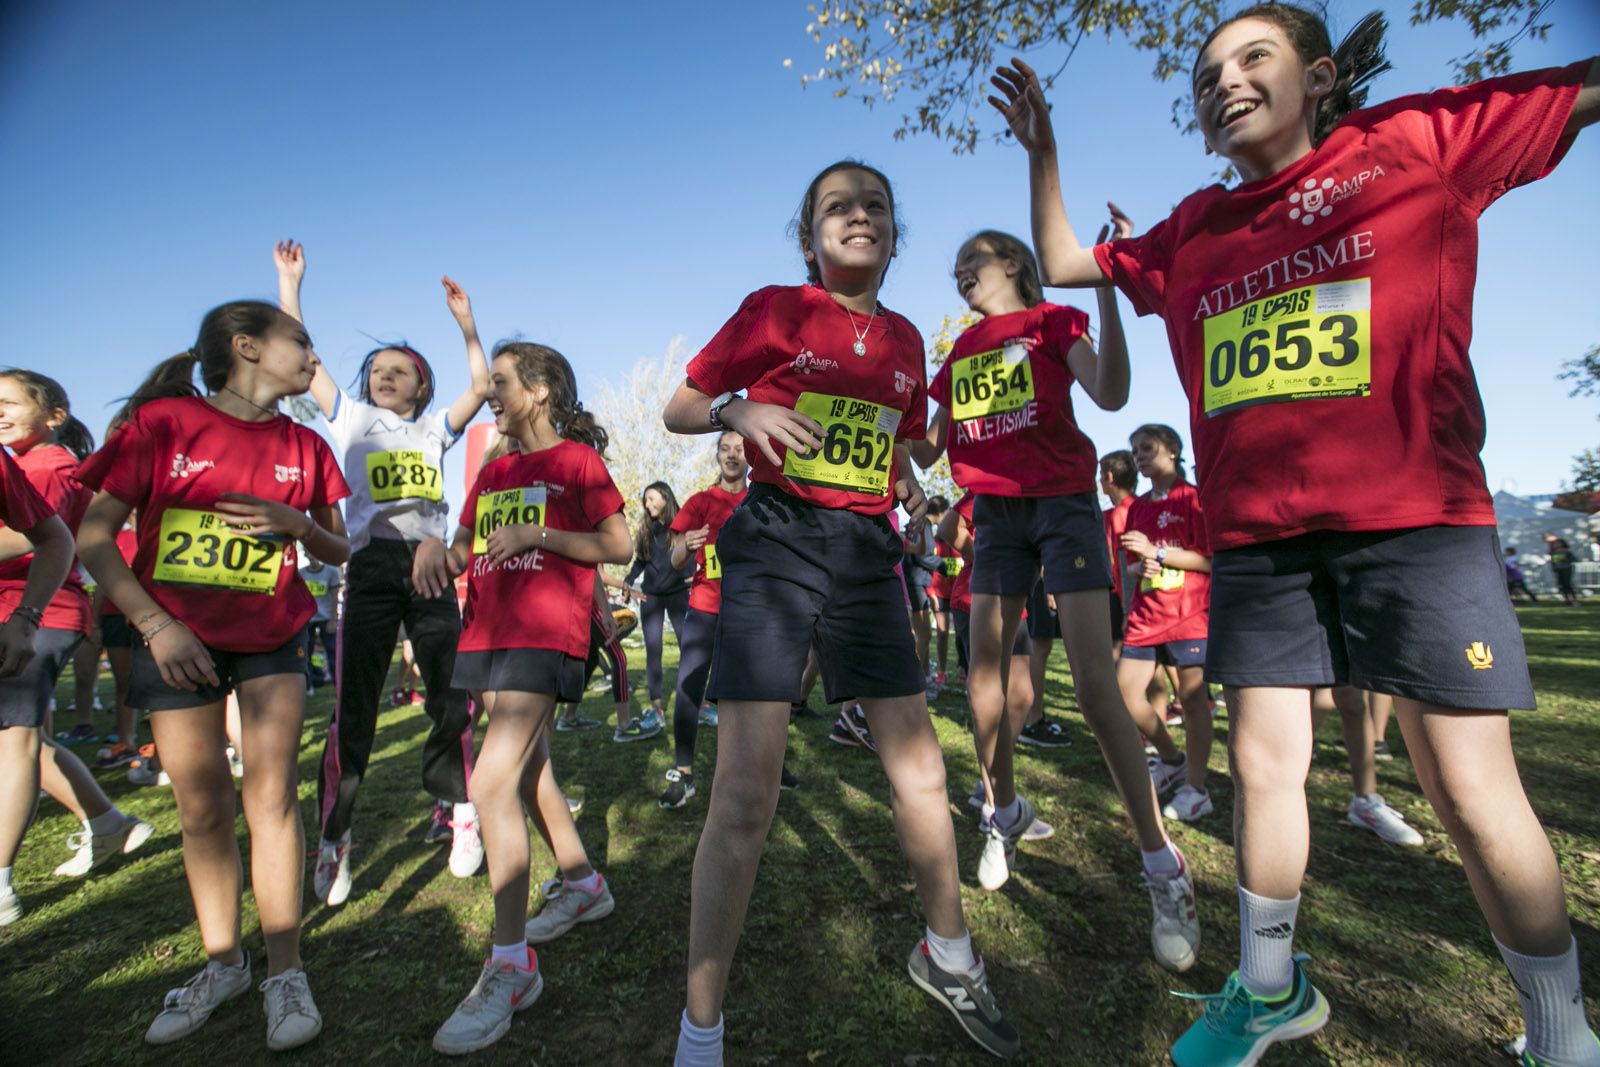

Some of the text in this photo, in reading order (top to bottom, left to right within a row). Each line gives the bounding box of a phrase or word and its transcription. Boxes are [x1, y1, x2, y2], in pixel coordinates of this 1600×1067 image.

[1331, 165, 1385, 199] AMPA
[1192, 231, 1376, 321] ATLETISME
[1241, 303, 1258, 329] 19
[809, 357, 839, 368] AMPA
[1210, 314, 1360, 388] 0653
[955, 364, 1028, 405] 0654
[829, 398, 846, 418] 19
[957, 402, 1038, 445] ATLETISME
[372, 464, 437, 489] 0287
[200, 514, 215, 529] 19
[163, 531, 276, 574] 2302
